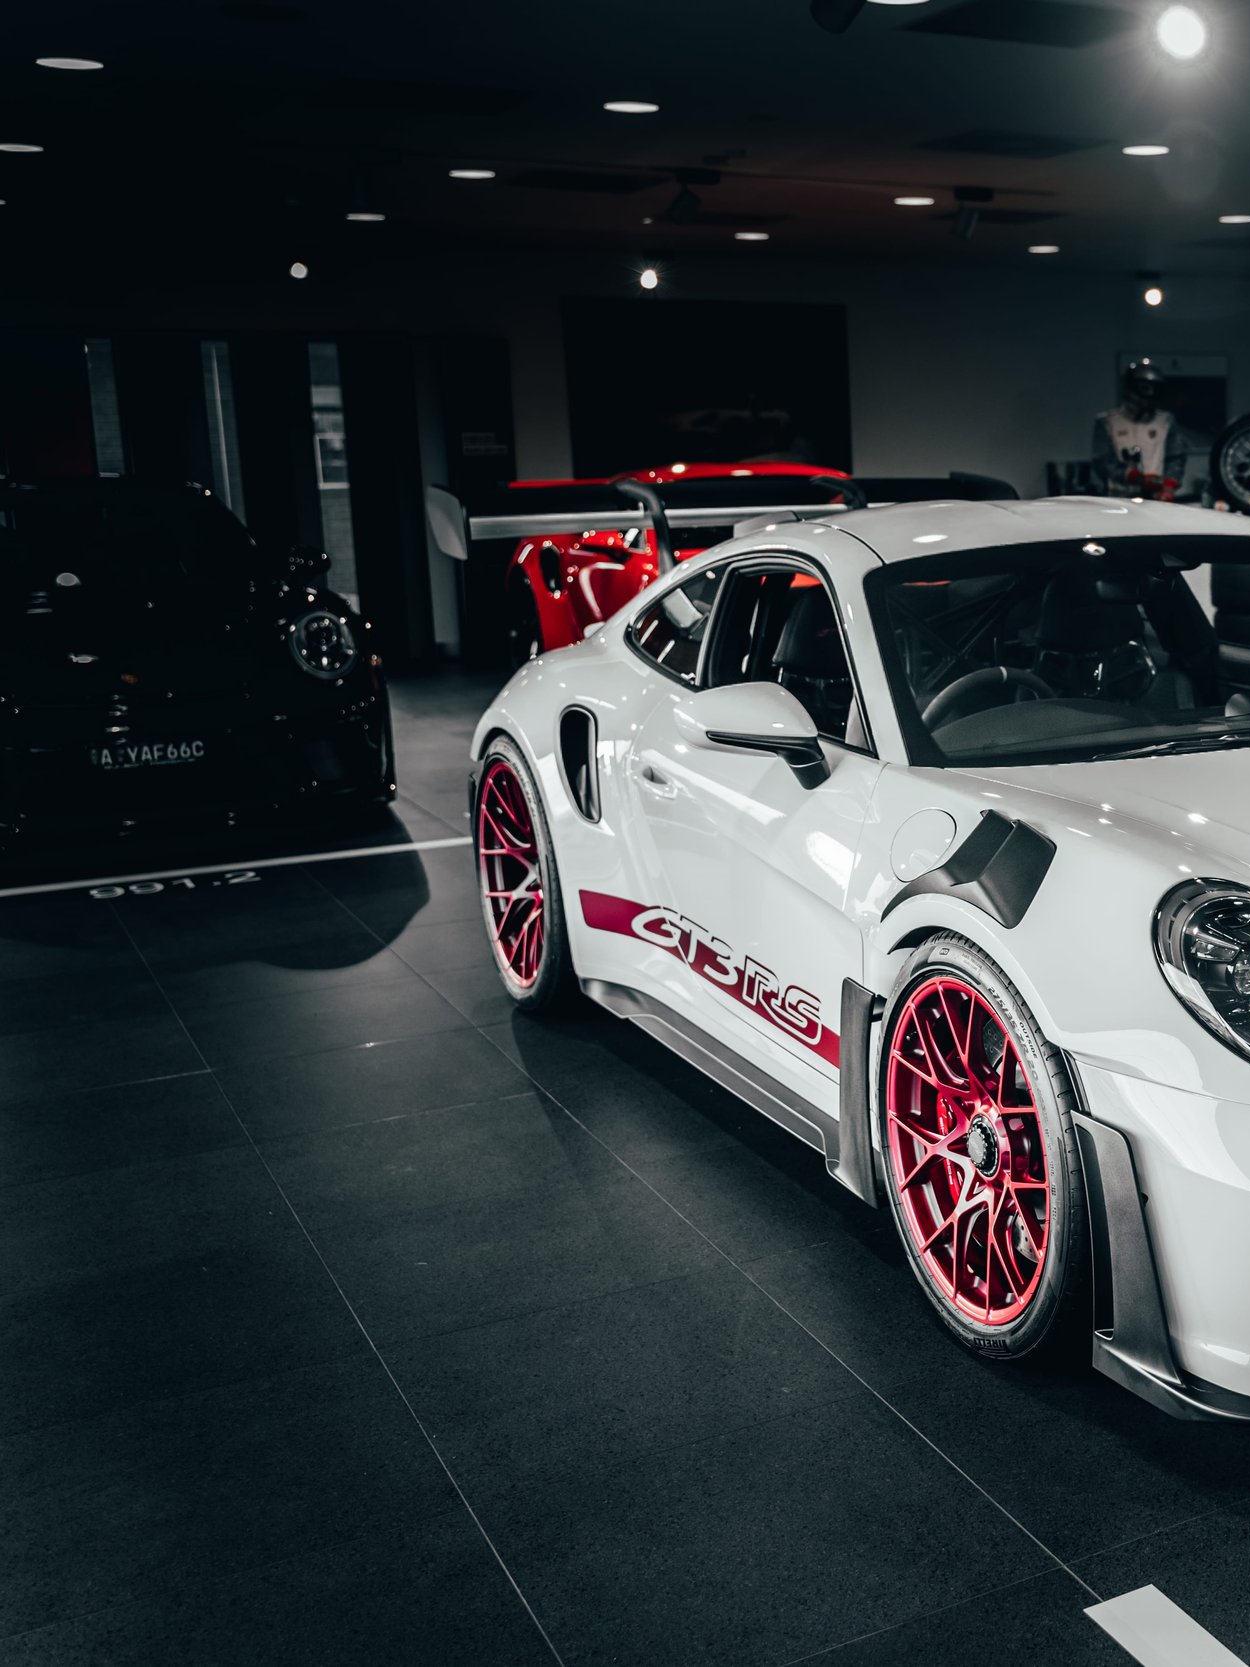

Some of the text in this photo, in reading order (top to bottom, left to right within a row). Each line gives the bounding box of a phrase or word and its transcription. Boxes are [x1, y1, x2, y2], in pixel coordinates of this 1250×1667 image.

[126, 740, 205, 763] YAF66C
[88, 870, 262, 899] 991.2
[1019, 1021, 1038, 1059] OUTSIDE
